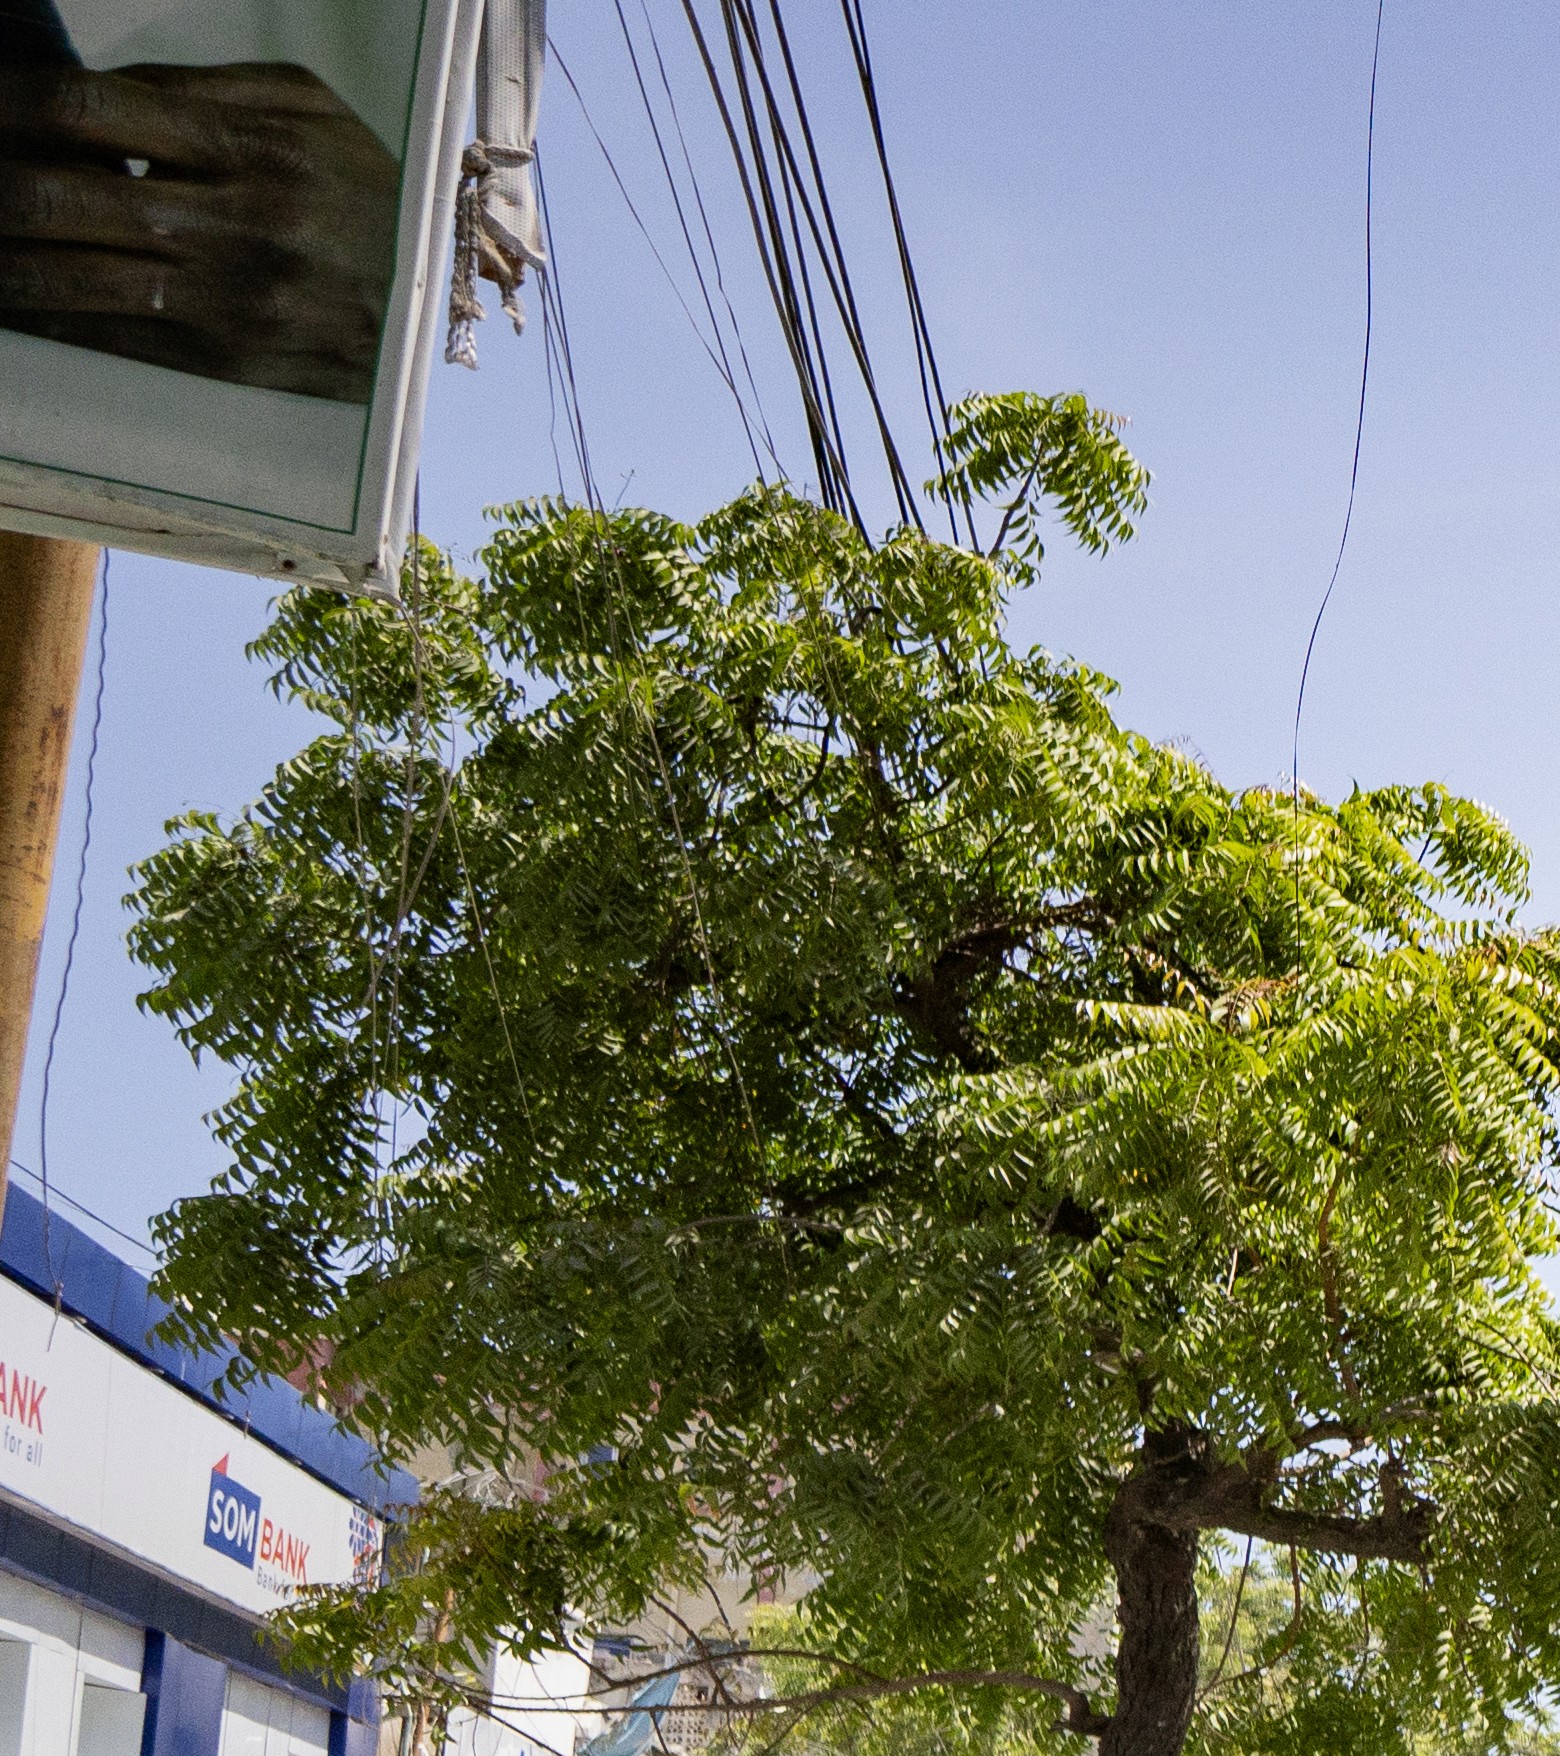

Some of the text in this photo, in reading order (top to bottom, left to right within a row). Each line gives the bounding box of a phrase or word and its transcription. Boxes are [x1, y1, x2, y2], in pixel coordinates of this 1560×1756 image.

[26, 1438, 43, 1467] all
[208, 1488, 257, 1553] SOM
[260, 1517, 311, 1584] BANK
